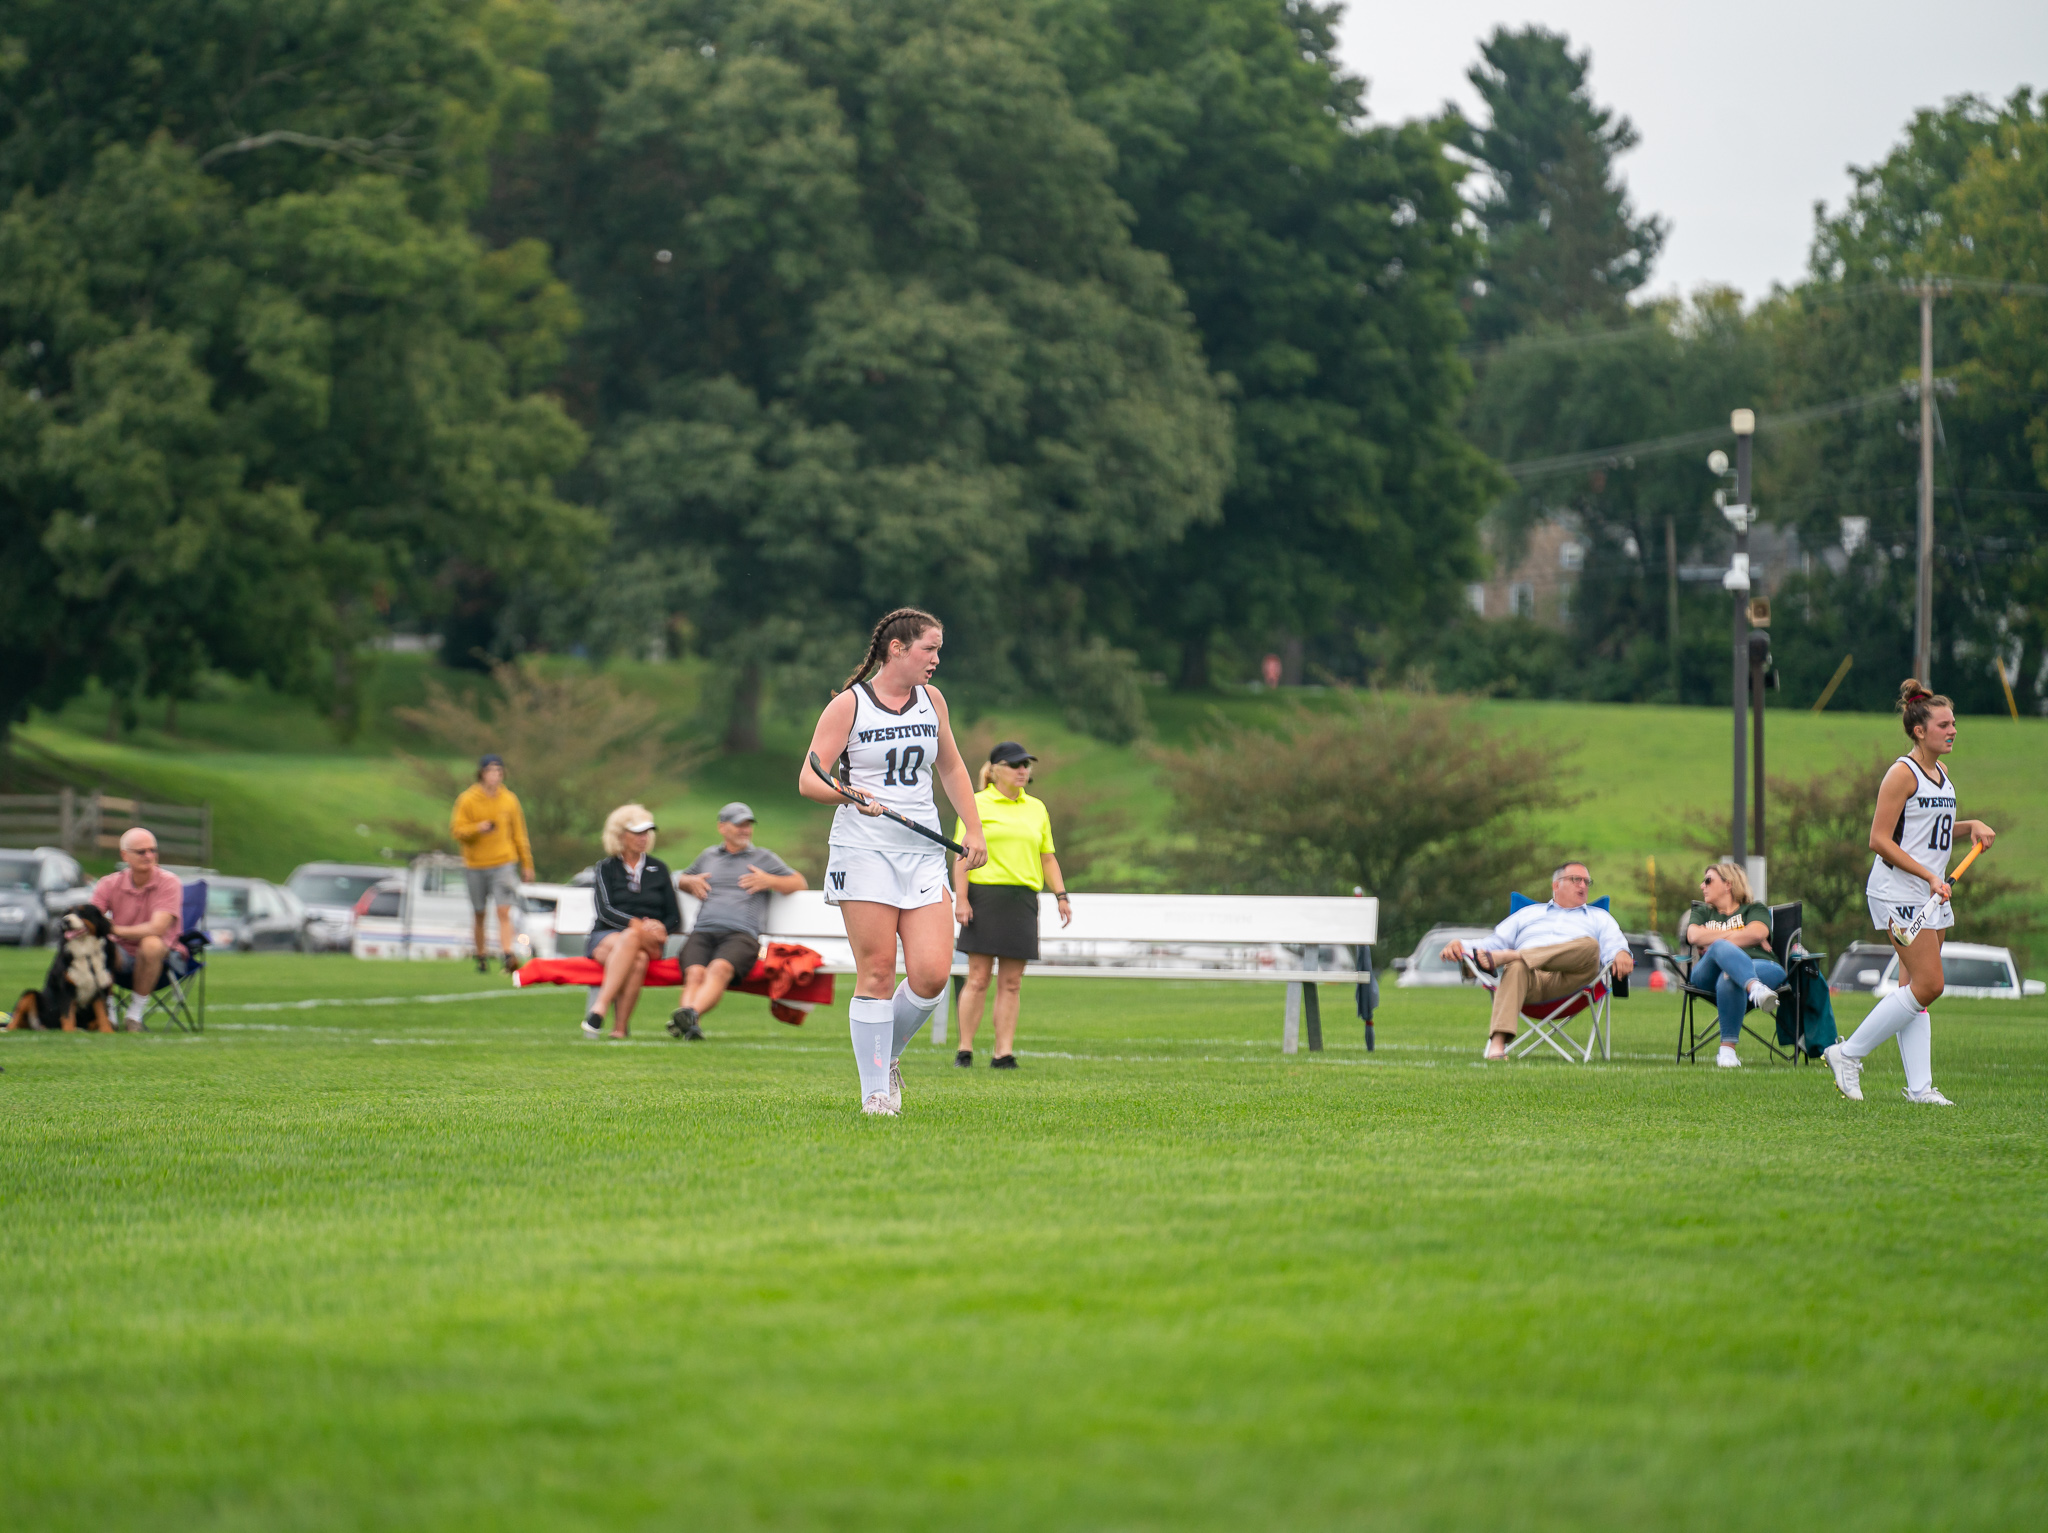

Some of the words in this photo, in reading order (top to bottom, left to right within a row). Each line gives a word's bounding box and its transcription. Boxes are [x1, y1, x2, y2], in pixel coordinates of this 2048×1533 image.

[883, 745, 925, 787] 10
[1928, 813, 1952, 851] 18
[829, 871, 847, 891] W
[1895, 906, 1915, 920] W
